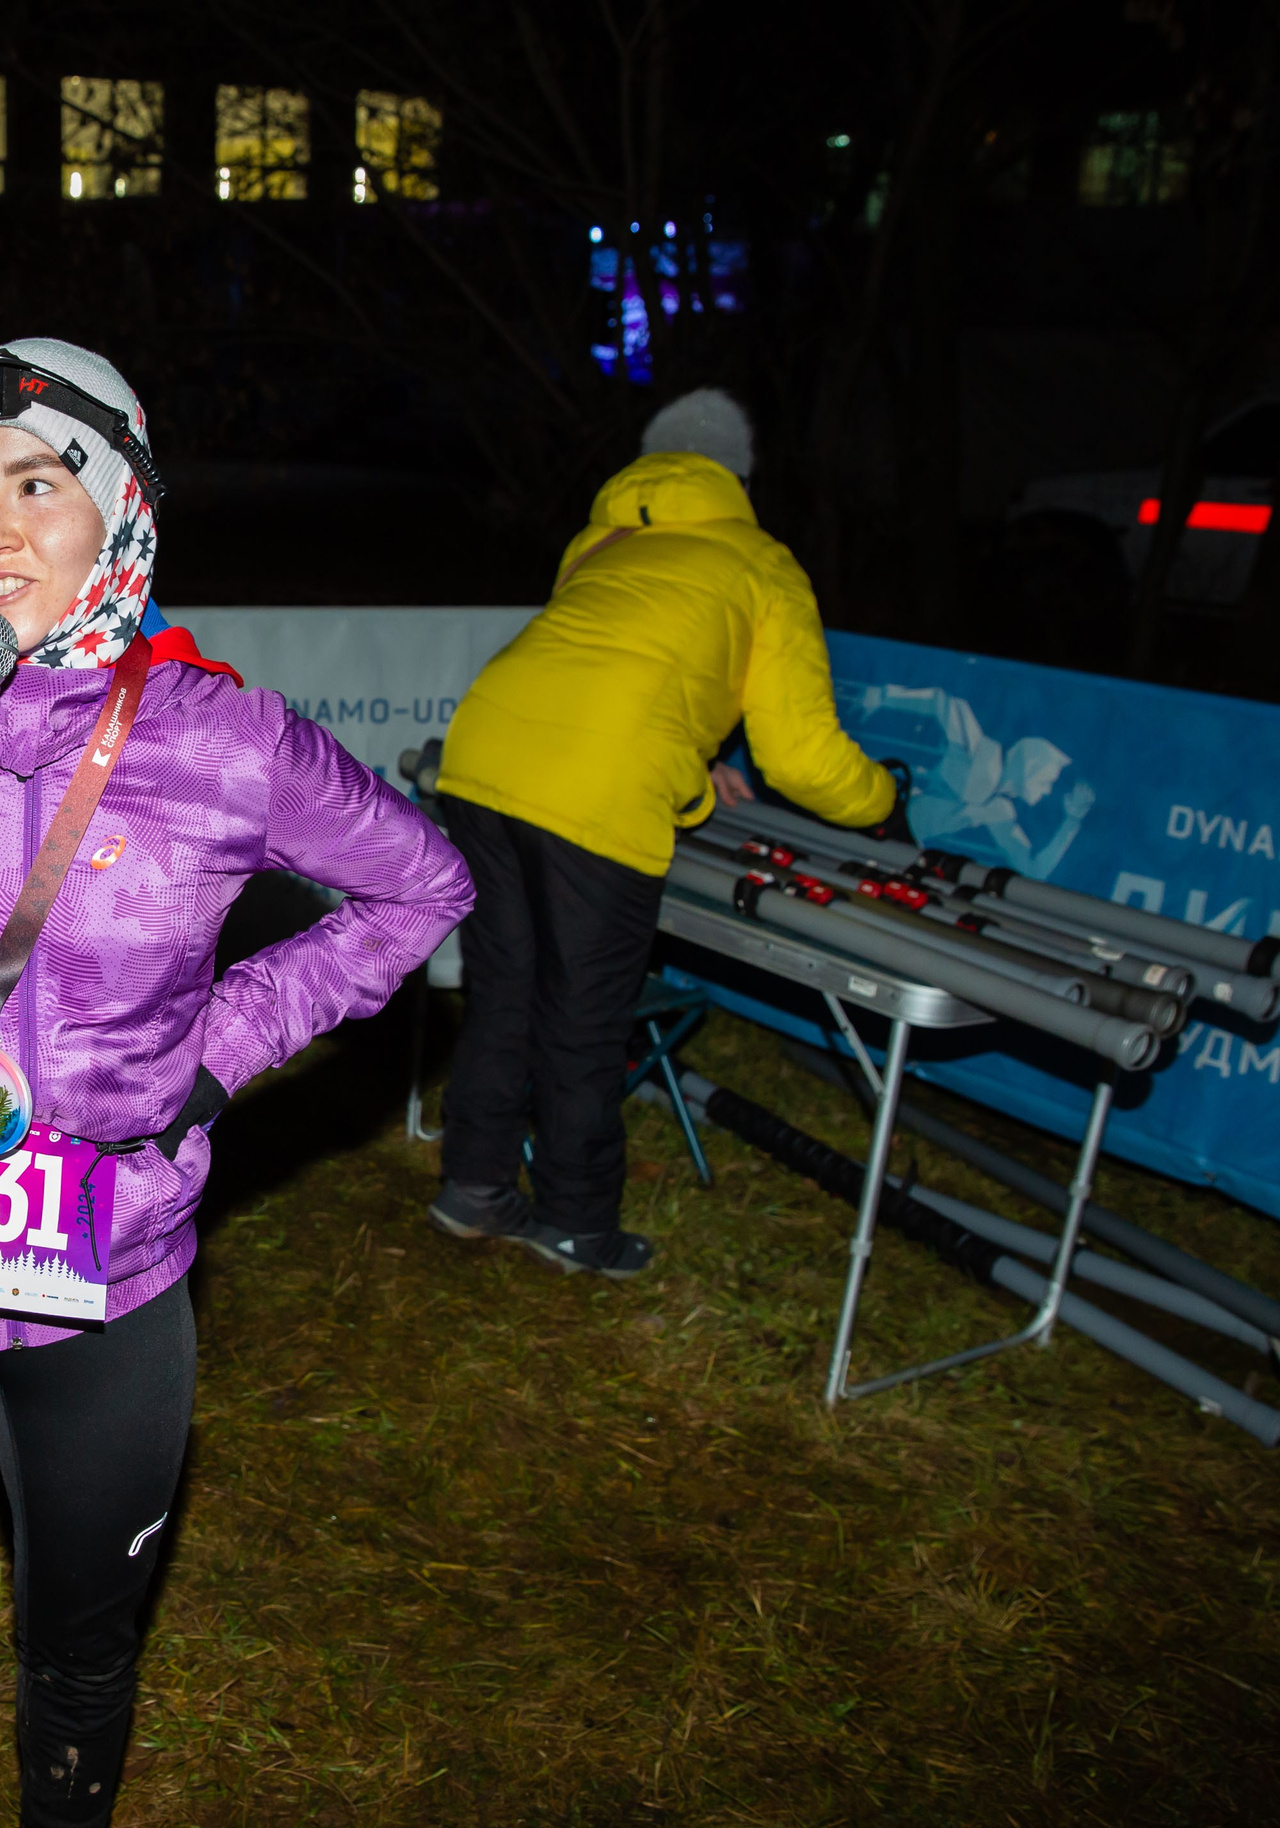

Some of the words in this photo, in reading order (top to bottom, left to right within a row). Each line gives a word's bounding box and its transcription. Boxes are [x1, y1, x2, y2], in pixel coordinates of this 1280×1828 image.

[100, 687, 127, 747] КАЛАШНИКОВ
[106, 721, 123, 748] СПОРТ
[1166, 804, 1276, 860] DYNA
[76, 1181, 96, 1227] 2024
